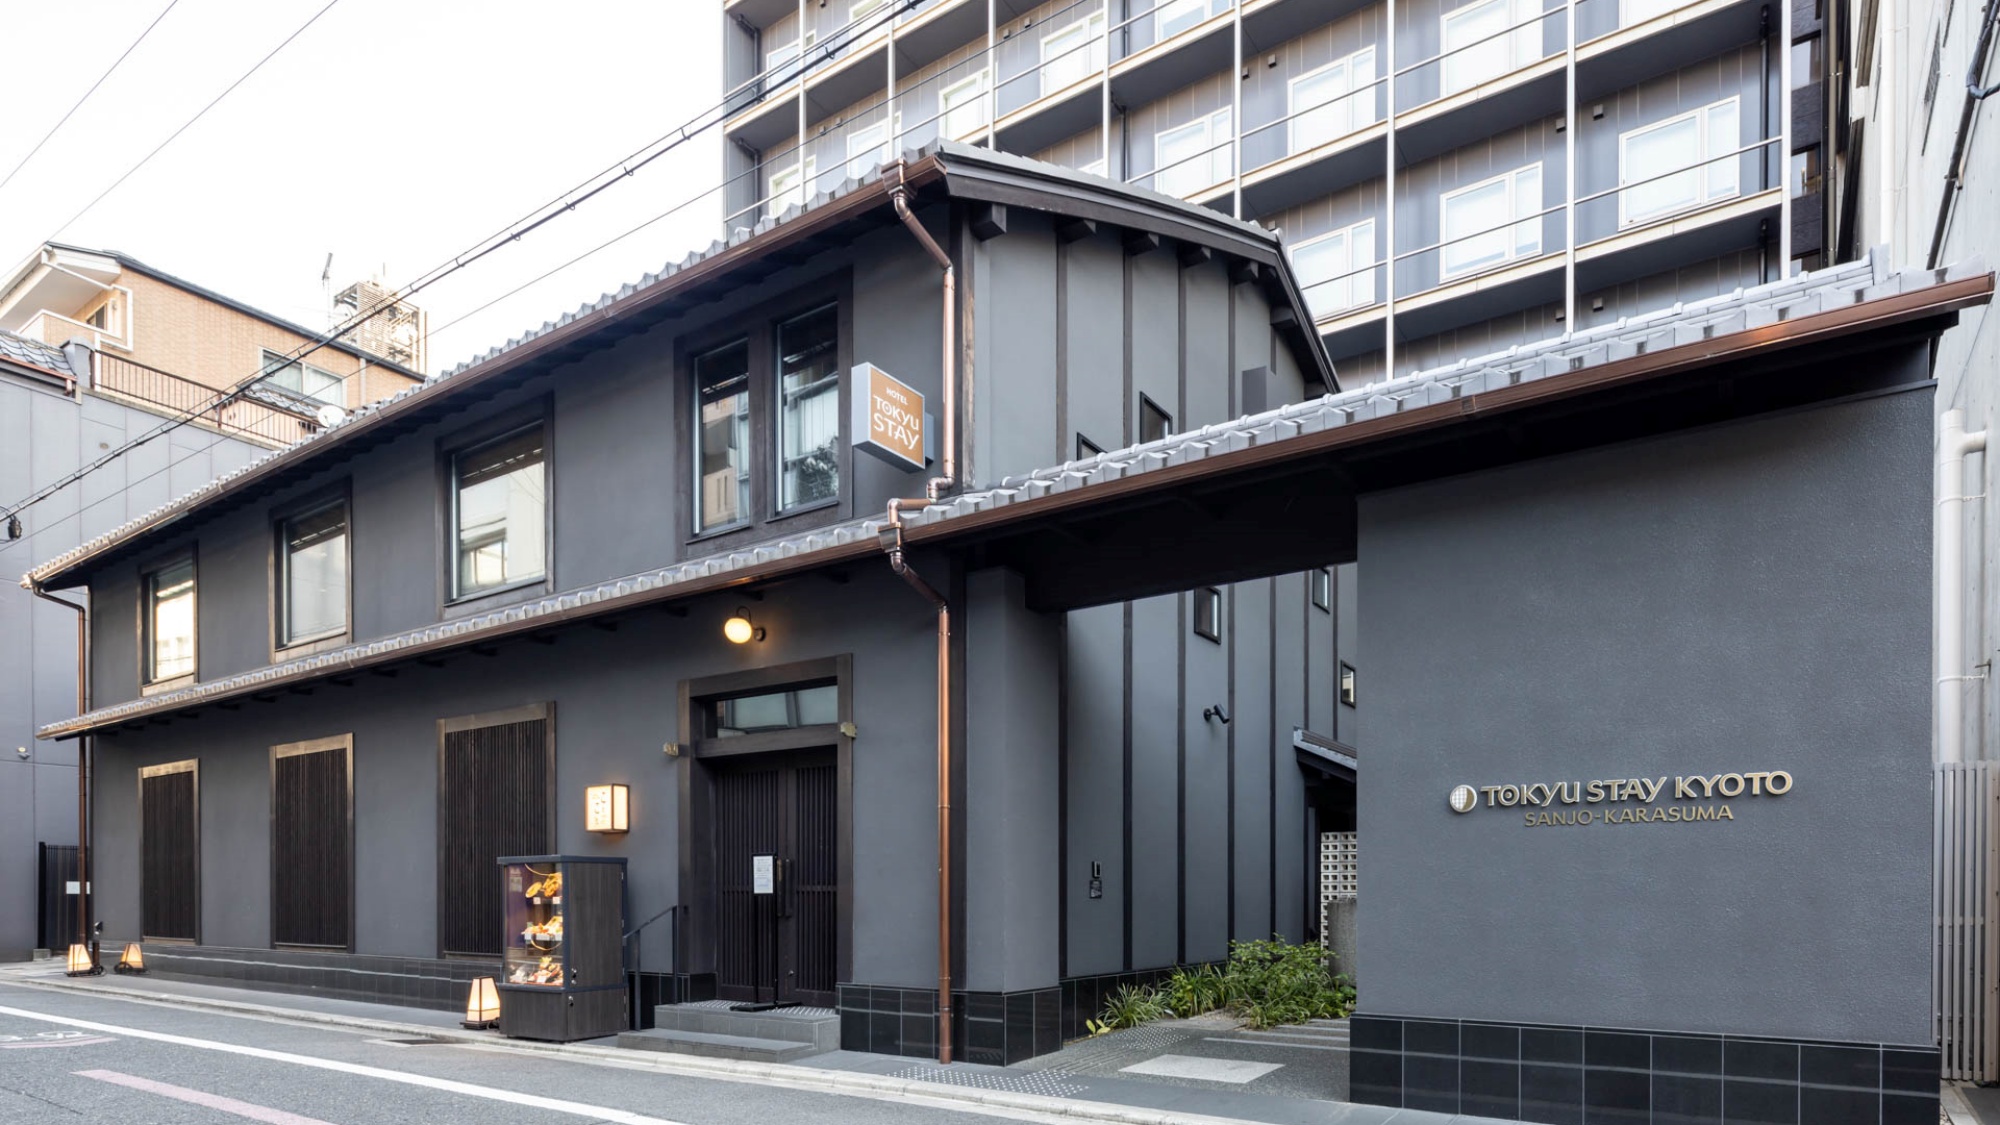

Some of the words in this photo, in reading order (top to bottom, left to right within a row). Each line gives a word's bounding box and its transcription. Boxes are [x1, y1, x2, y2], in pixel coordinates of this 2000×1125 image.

[873, 394, 919, 431] TOKYU
[886, 387, 908, 405] HOTEL
[873, 412, 919, 450] STAY
[1481, 781, 1580, 807] TOKYU
[1587, 776, 1667, 803] STAY
[1675, 770, 1794, 799] KYOTO
[1524, 805, 1734, 827] SANJO-KARASUMA
